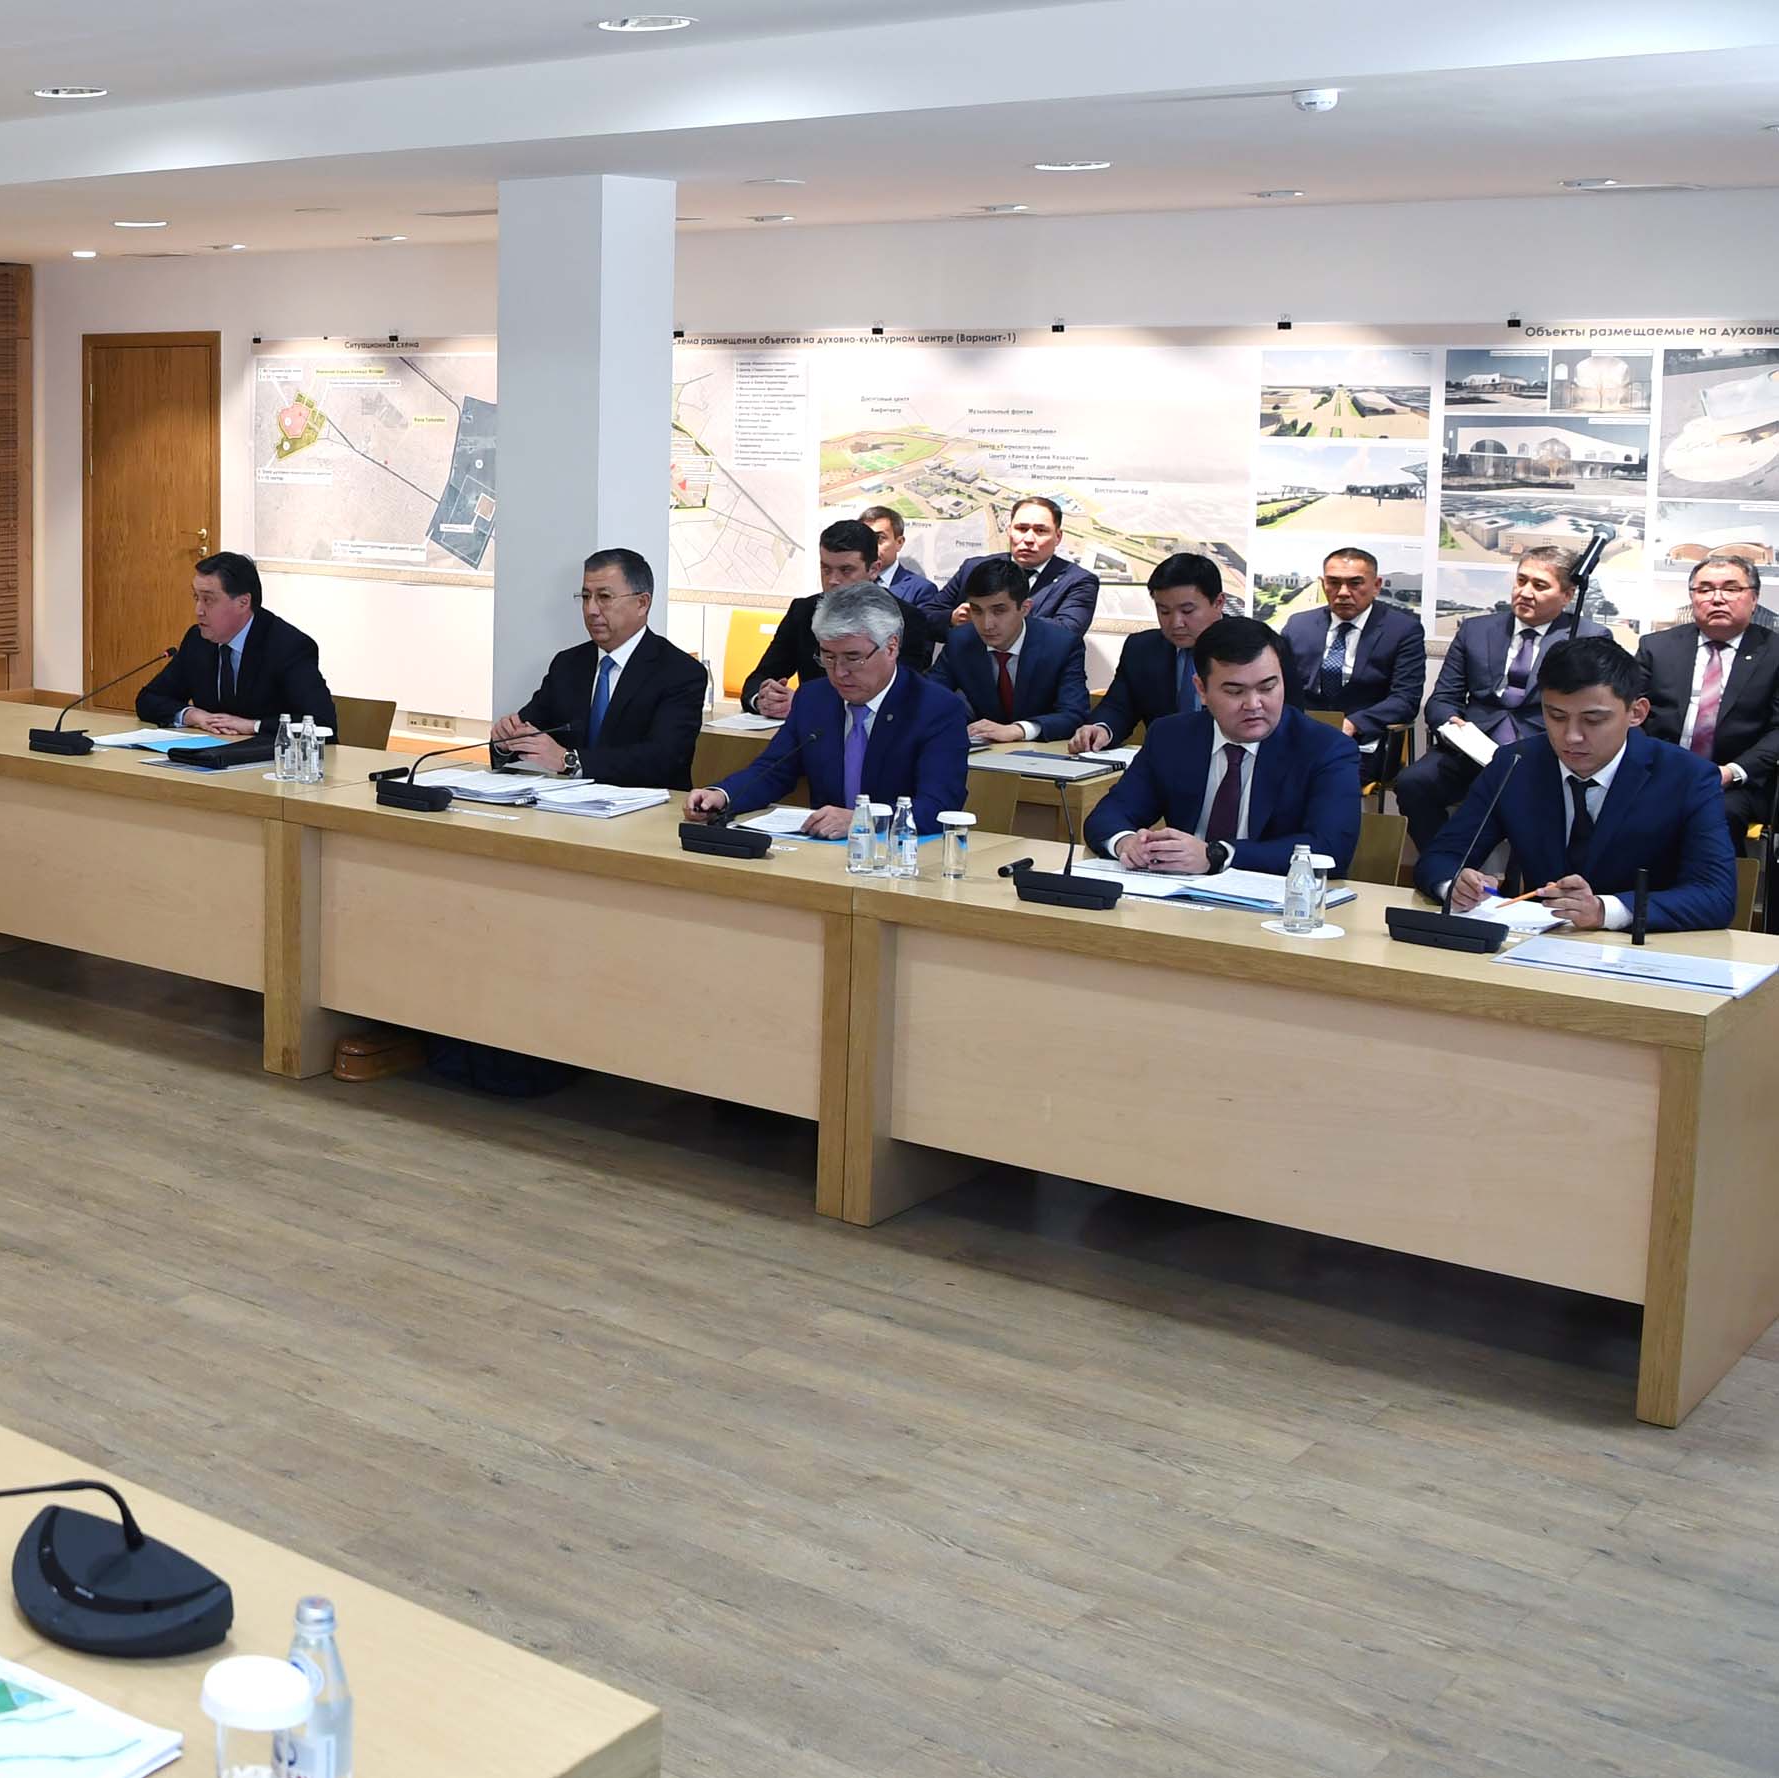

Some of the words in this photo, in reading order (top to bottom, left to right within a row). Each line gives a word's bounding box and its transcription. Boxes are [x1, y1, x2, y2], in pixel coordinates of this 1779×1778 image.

[1525, 326, 1586, 338] Объекты
[1589, 327, 1695, 338] размещаемые
[1699, 327, 1717, 336] на
[673, 337, 699, 346] хема
[701, 337, 757, 346] размещения
[759, 336, 801, 345] объектов
[817, 335, 916, 346] духовно-культурном
[917, 335, 954, 345] центре
[956, 332, 1017, 345] (Вариант-1)
